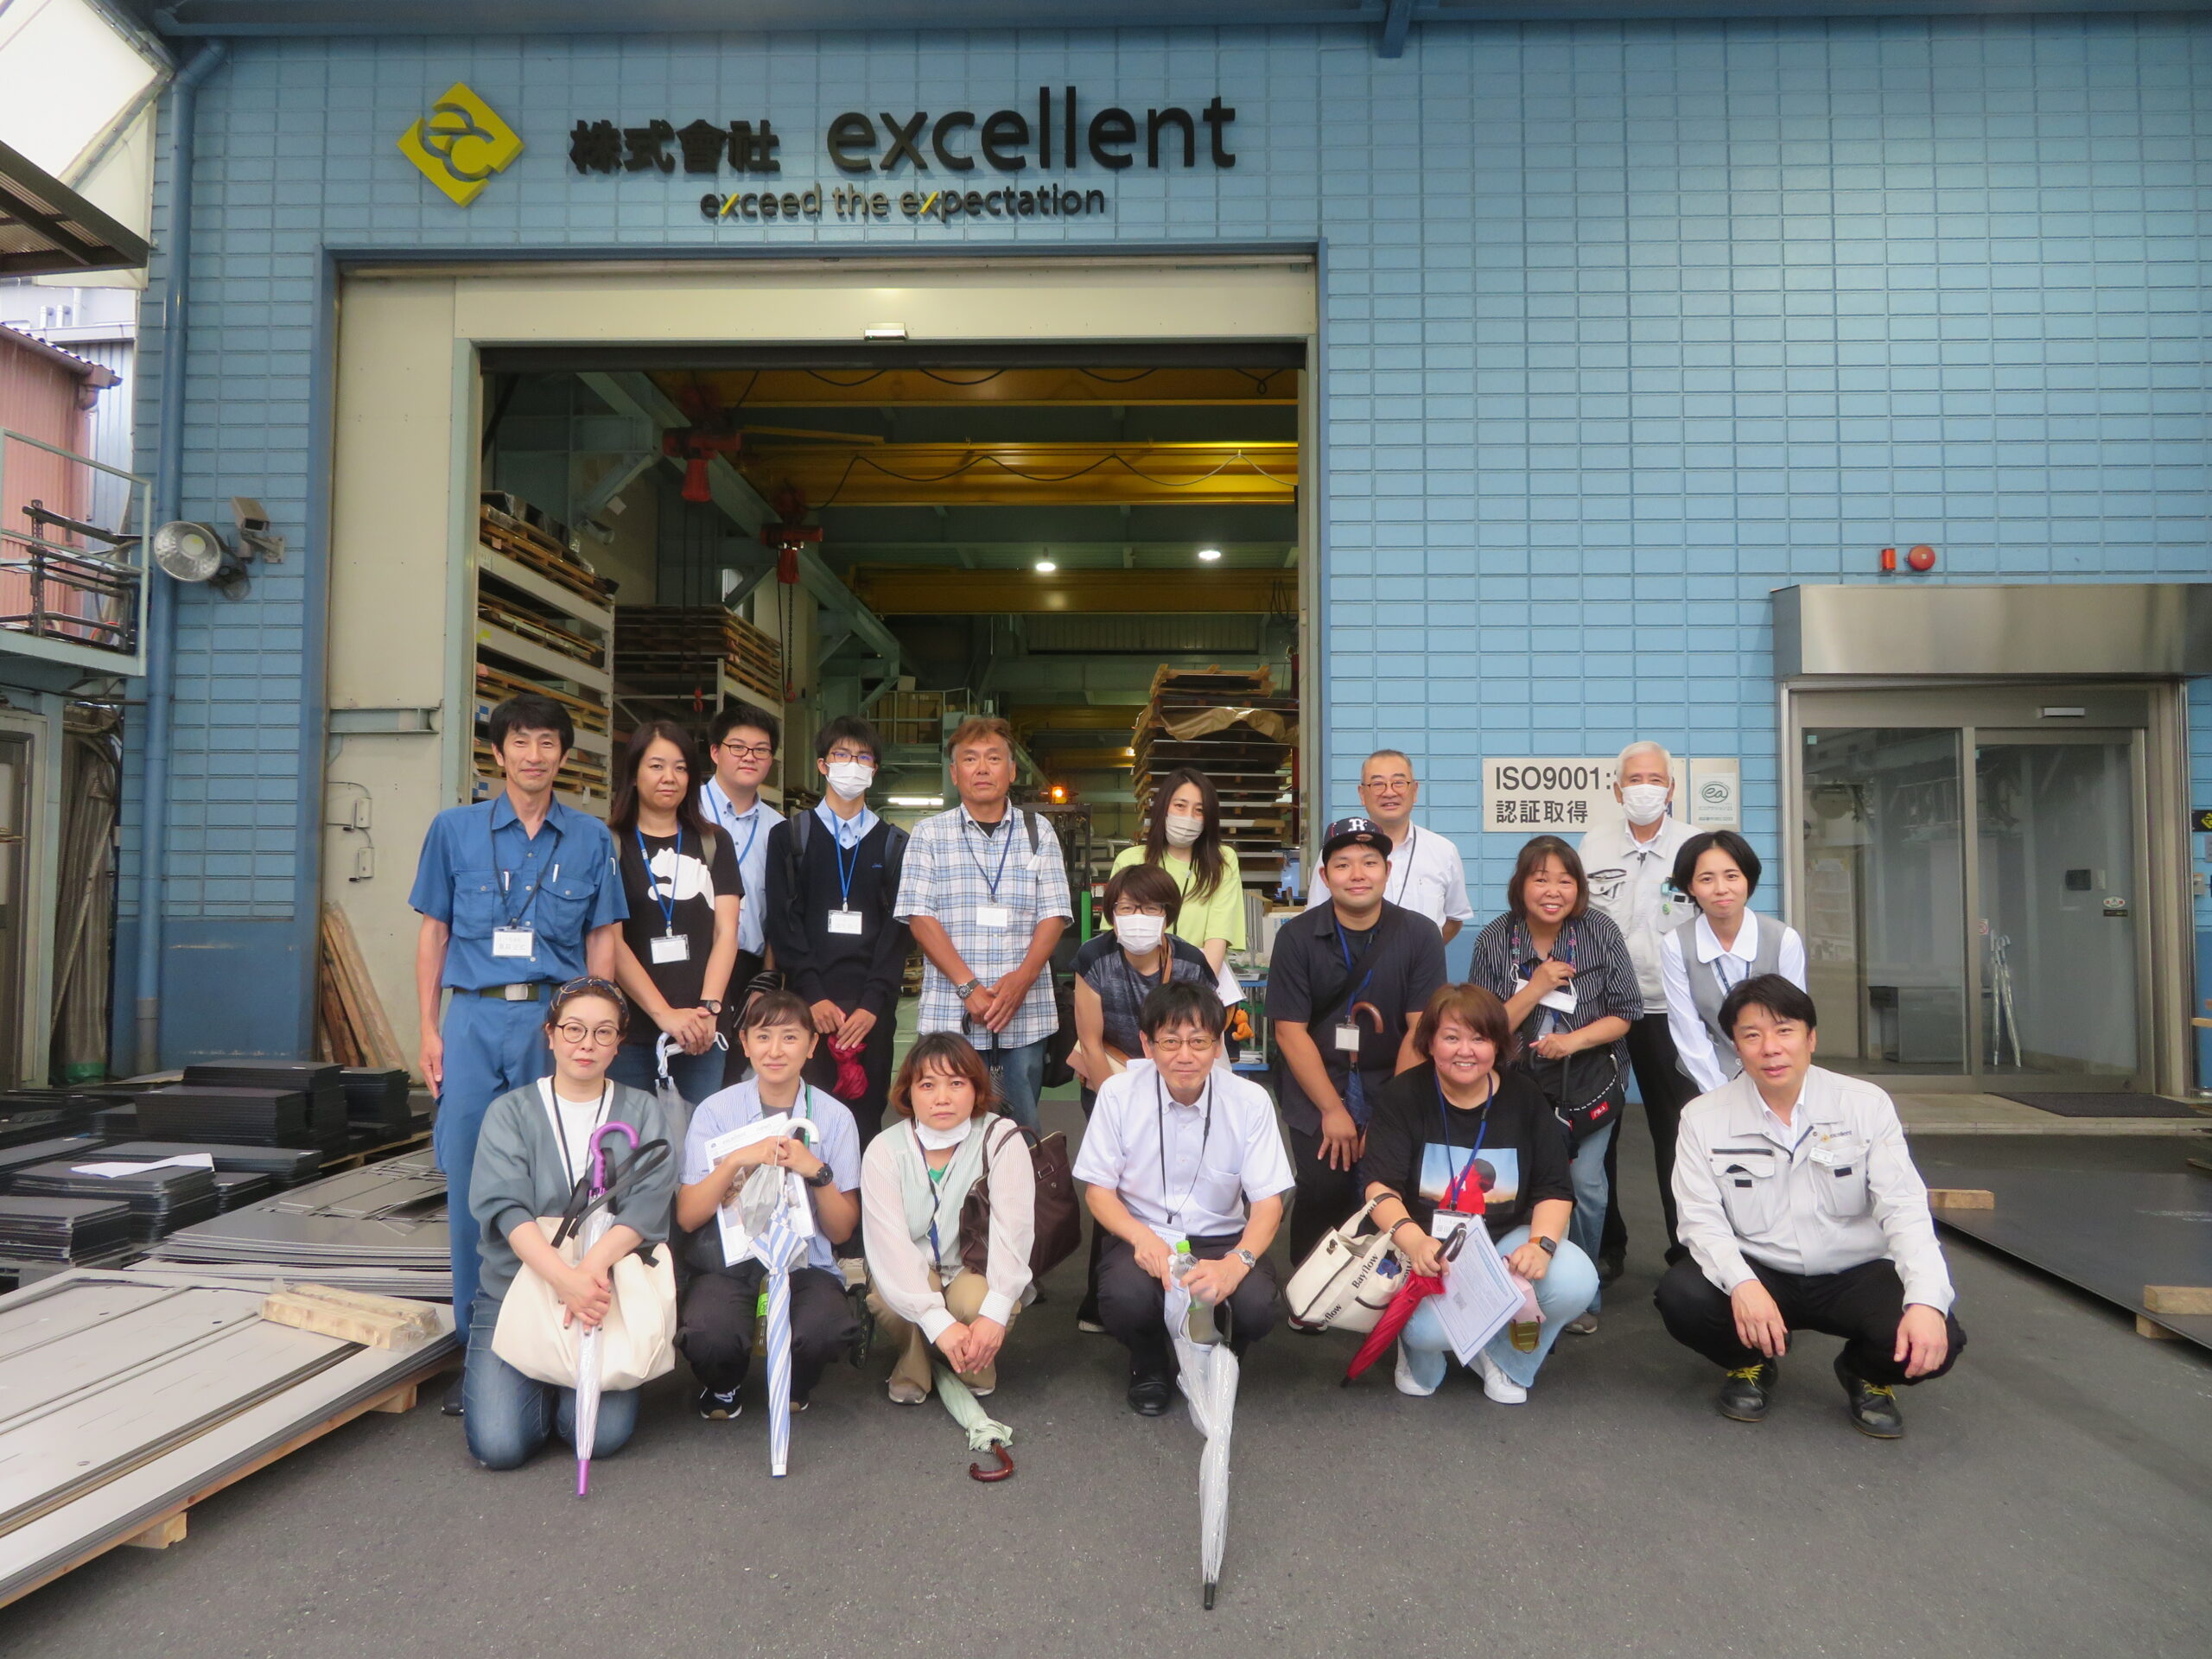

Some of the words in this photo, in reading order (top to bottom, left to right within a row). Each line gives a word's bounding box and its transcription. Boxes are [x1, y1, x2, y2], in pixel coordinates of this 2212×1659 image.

[826, 86, 1236, 172] excellent
[700, 181, 822, 218] exceed
[832, 182, 889, 217] the
[899, 183, 1105, 223] expectation
[1496, 766, 1617, 791] ISO9001:
[1496, 800, 1588, 823] 認証取得
[1351, 1254, 1379, 1289] Bayflow
